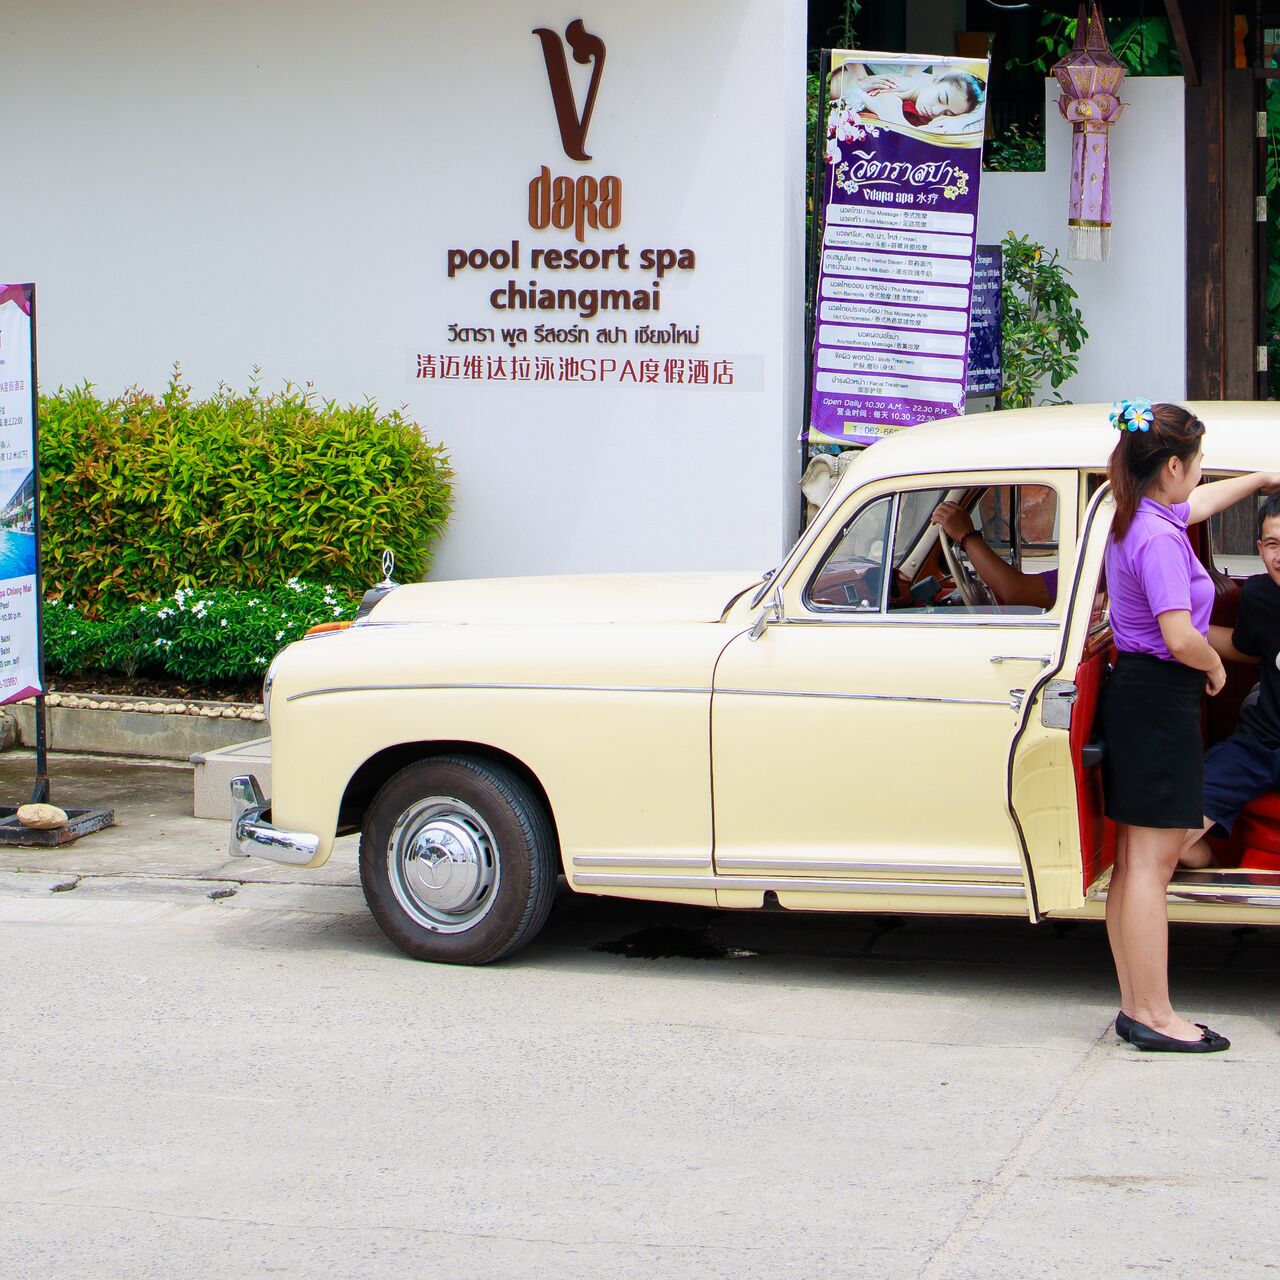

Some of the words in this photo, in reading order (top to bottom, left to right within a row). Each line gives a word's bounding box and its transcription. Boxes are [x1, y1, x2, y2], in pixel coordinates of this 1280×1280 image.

[850, 150, 953, 186] วีดาราสปา
[528, 165, 622, 243] dara
[916, 192, 938, 205] 水疗
[877, 210, 899, 218] Massage
[447, 240, 519, 278] pool
[531, 243, 629, 271] resort
[640, 247, 695, 278] spa
[489, 280, 661, 319] chiangmai
[447, 323, 495, 344] วีดารา
[501, 328, 528, 348] พูล
[534, 324, 589, 344] รีสอร์ท
[596, 325, 627, 344] สปา
[634, 323, 700, 345] เชียงใหม่
[823, 397, 842, 406] Open
[844, 399, 863, 408] Daily
[864, 401, 885, 409] 10.30
[912, 405, 933, 413] 22.30
[891, 413, 910, 421] 10.30
[6, 586, 22, 597] Chiang
[0, 601, 10, 609] Pool
